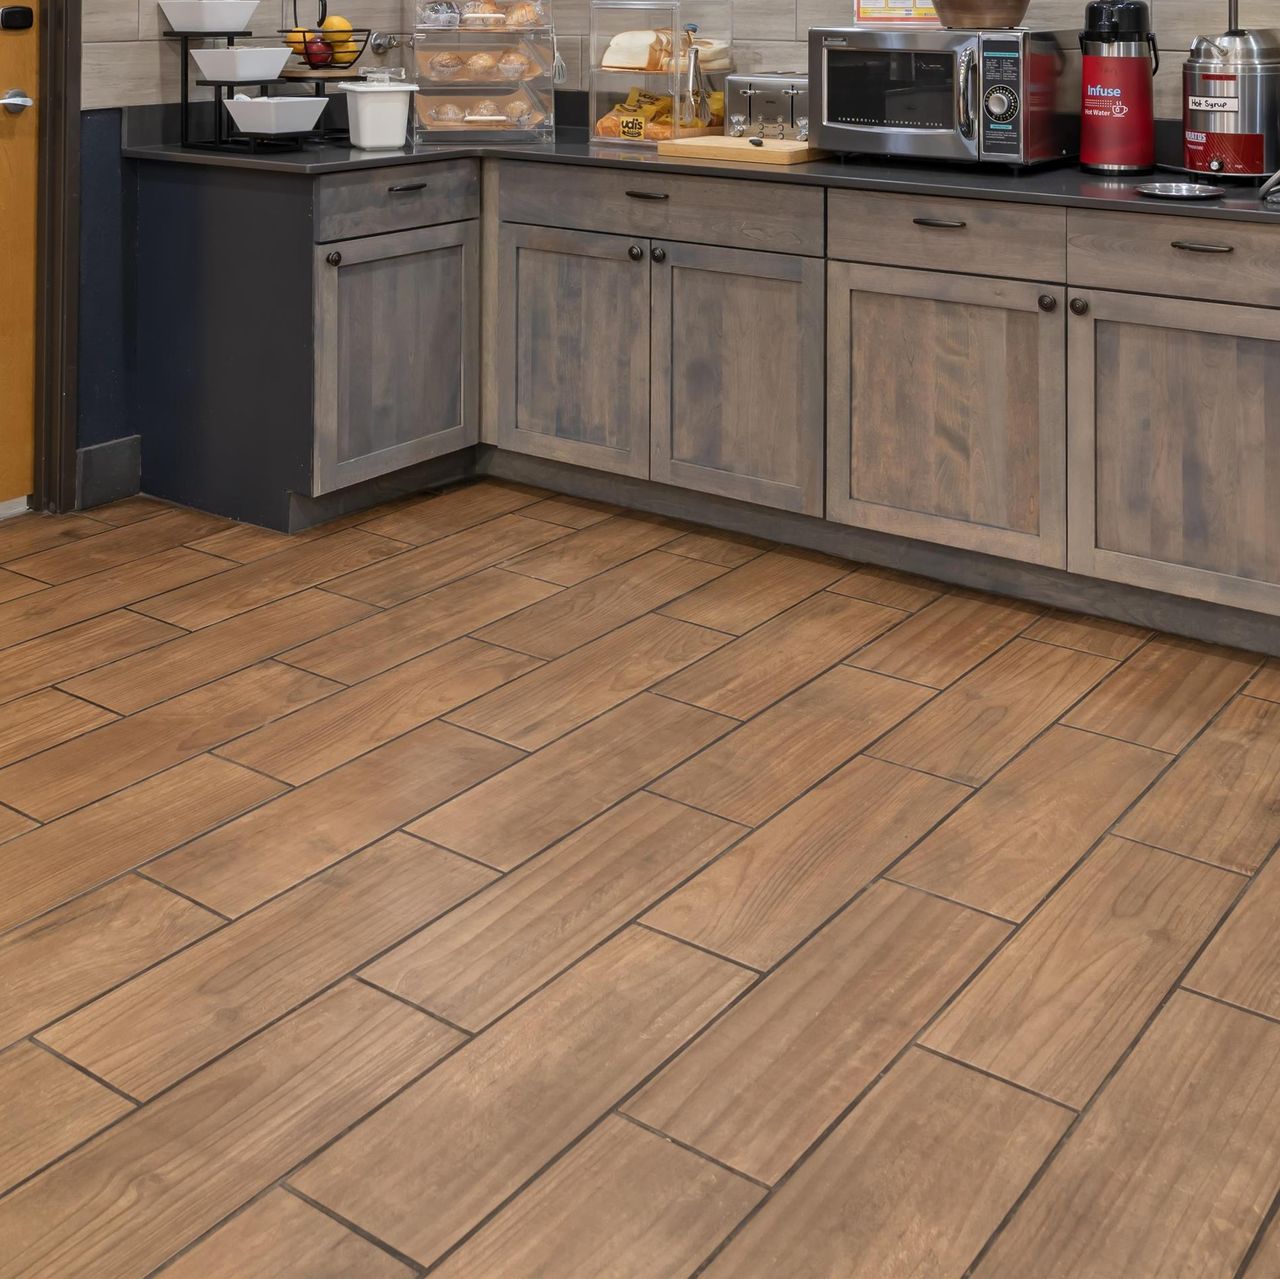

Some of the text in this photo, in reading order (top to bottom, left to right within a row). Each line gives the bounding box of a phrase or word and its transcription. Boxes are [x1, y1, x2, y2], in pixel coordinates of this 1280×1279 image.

[1087, 85, 1121, 97] Infuse
[1191, 99, 1227, 109] Hot Syrup
